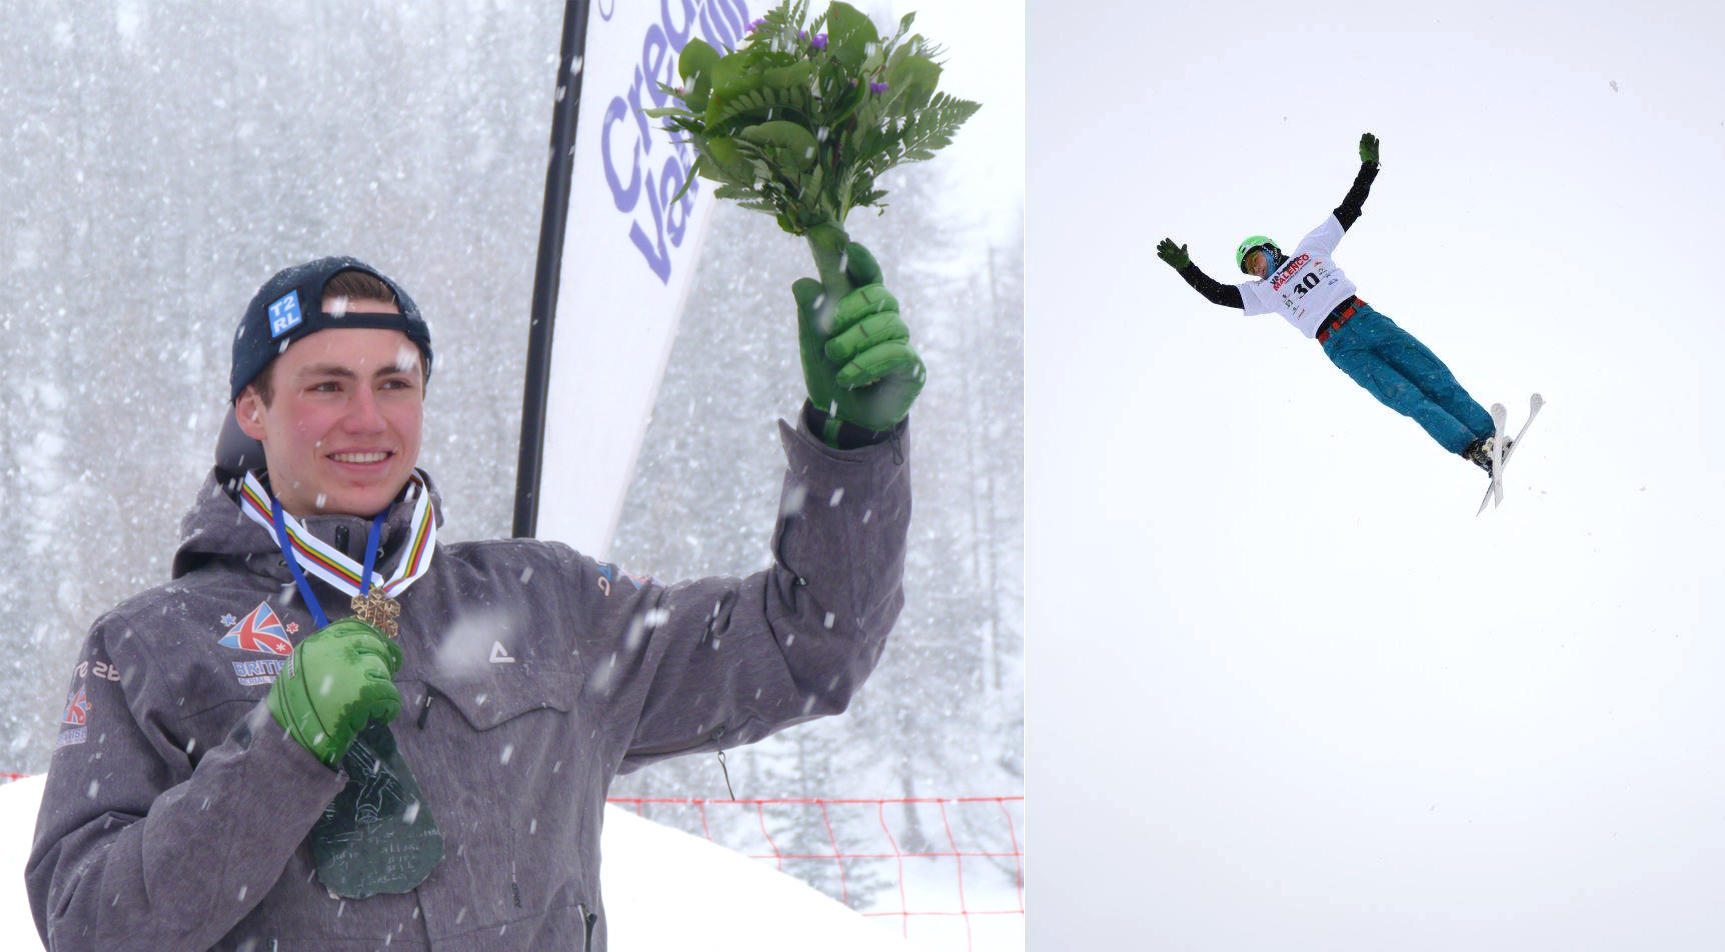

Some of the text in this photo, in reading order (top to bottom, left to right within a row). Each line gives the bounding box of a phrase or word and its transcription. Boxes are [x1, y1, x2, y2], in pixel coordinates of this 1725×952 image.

[1273, 253, 1309, 291] MALENCO
[1293, 272, 1320, 299] 30
[270, 295, 296, 317] T2
[273, 312, 299, 333] RL
